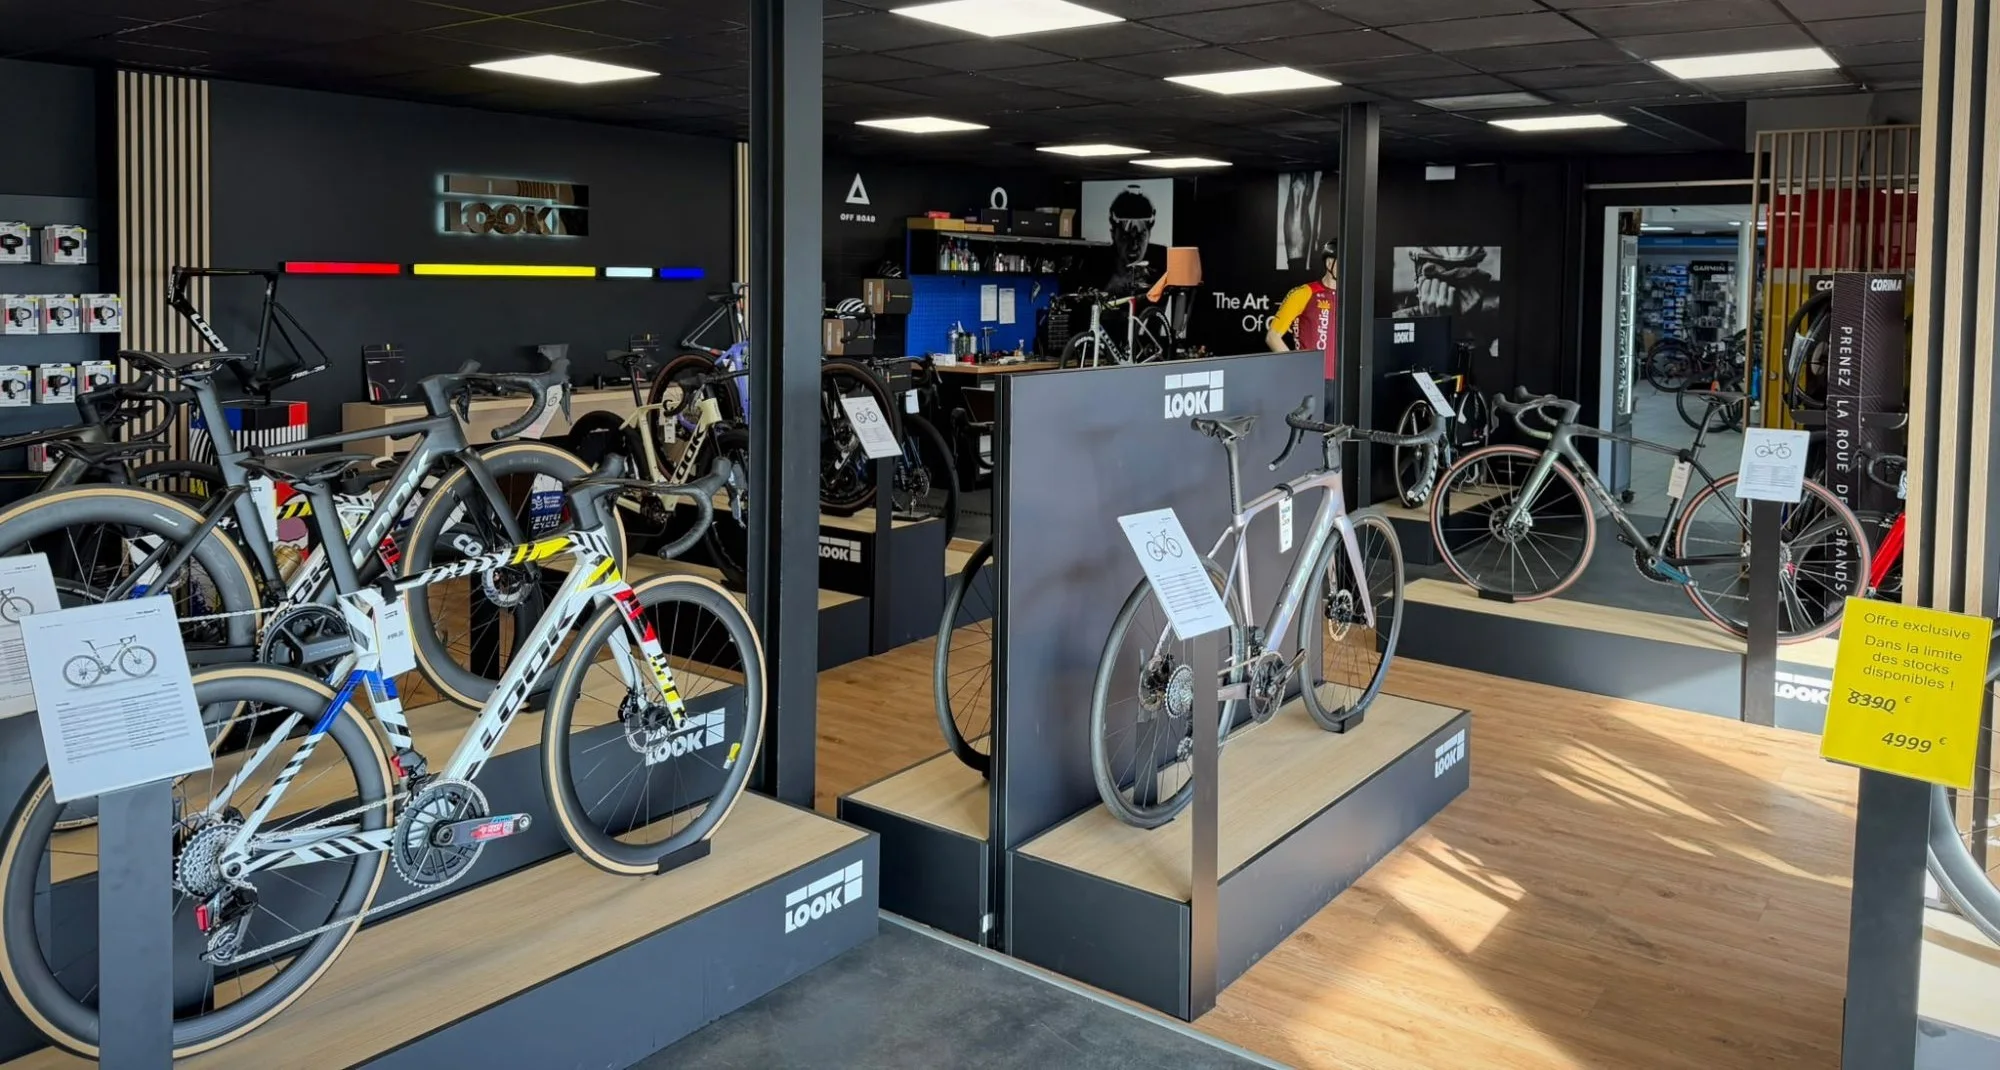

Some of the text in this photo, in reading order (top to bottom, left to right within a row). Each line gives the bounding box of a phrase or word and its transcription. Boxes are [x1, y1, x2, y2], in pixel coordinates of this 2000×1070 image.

[444, 200, 553, 236] LOOK
[840, 213, 876, 223] OFF ROAD
[1871, 278, 1902, 292] CORIMA
[1213, 292, 1270, 310] The Art
[1242, 314, 1264, 332] Of
[1837, 326, 1853, 387] PRENEZ
[1164, 389, 1209, 419] LOOK
[1836, 400, 1849, 418] LA
[1836, 429, 1849, 474] ROUE
[818, 545, 849, 561] LOOK
[1835, 527, 1848, 591] GRANDS
[1864, 612, 1971, 640] Offre exclusive
[1865, 634, 1962, 662] Dans la limite
[1863, 665, 1945, 690] disponibles
[1872, 652, 1949, 675] des stocks
[480, 613, 576, 751] LOOK
[1847, 689, 1896, 713] 8390
[645, 728, 704, 767] LOOK
[1881, 732, 1932, 753] 4999
[1434, 747, 1457, 779] LOOK
[785, 886, 843, 934] LOOK
